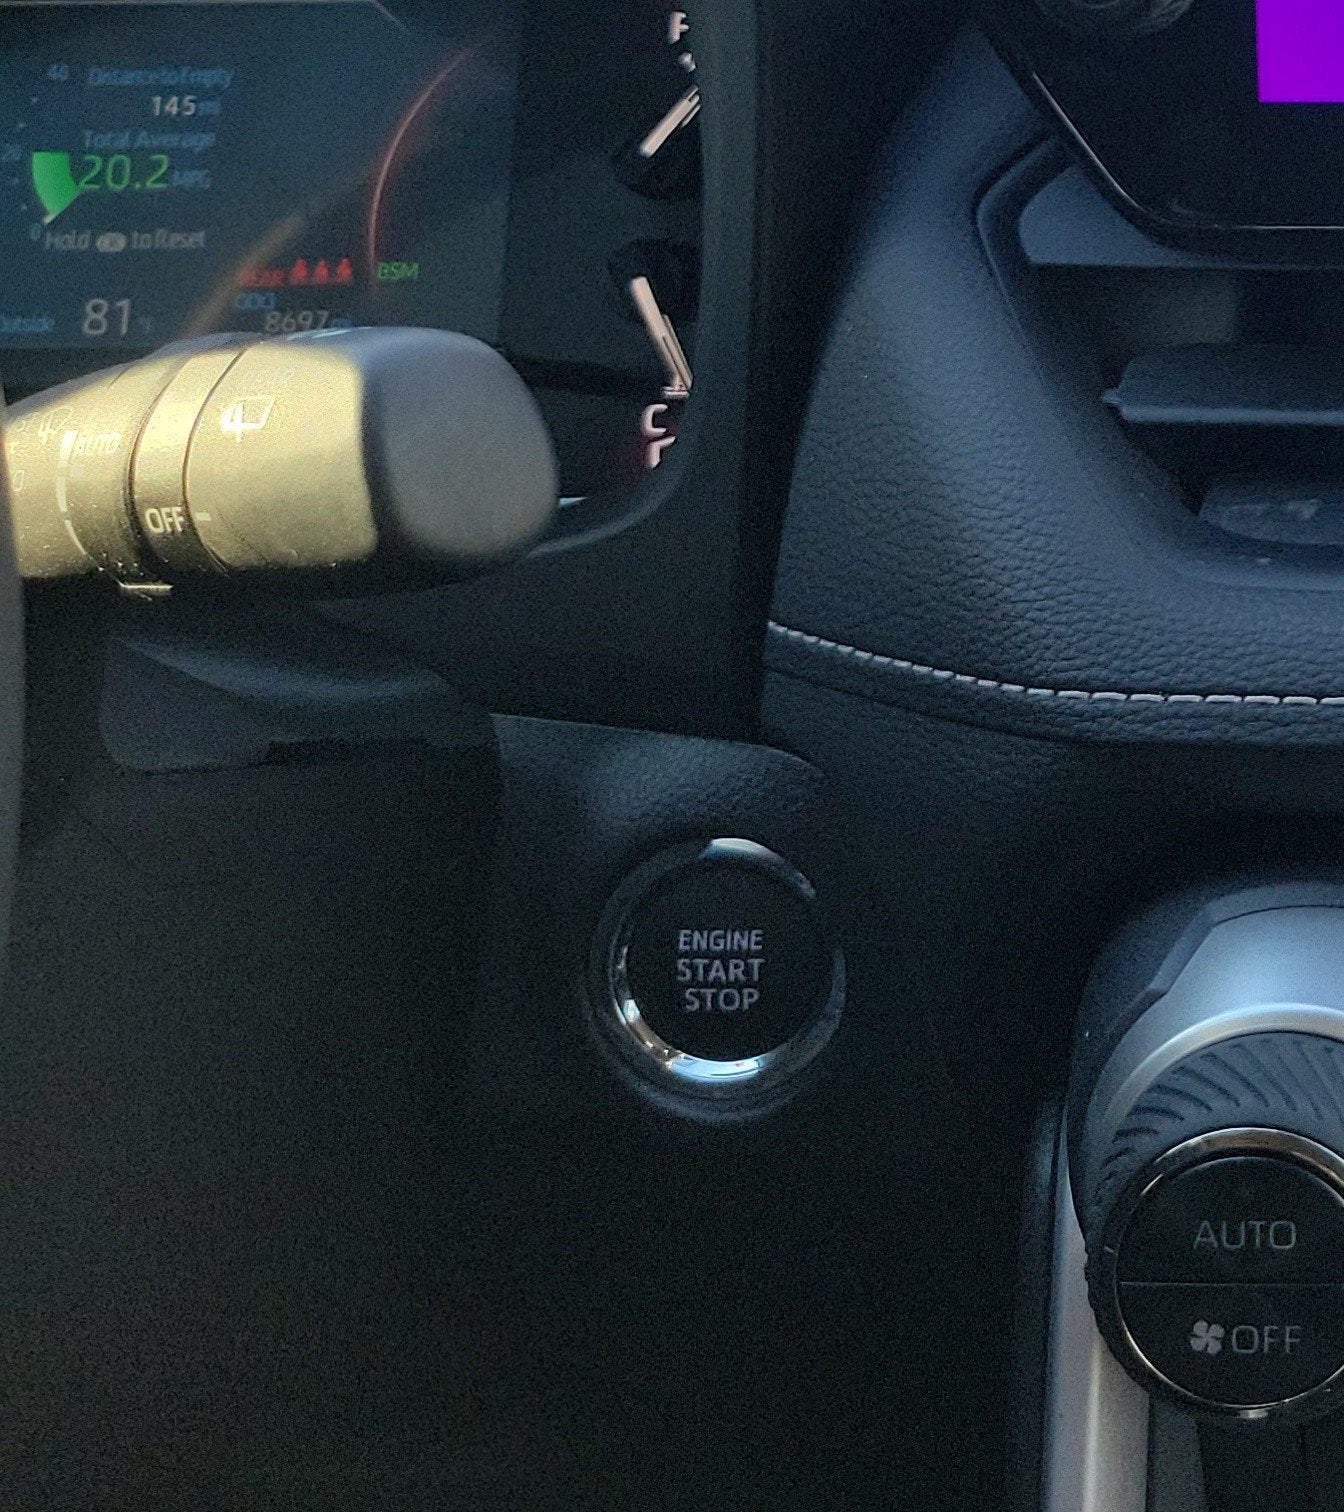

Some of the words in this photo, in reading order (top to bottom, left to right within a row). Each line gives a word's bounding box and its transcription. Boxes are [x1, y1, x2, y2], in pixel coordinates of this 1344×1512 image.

[667, 12, 690, 43] F
[152, 94, 197, 116] 145
[80, 153, 170, 190] 20.2
[82, 298, 131, 336] 81
[145, 506, 184, 534] OFF
[677, 928, 764, 952] ENGINE
[676, 957, 766, 983] START
[684, 987, 760, 1012] STOP
[1192, 1219, 1298, 1251] AUTO
[1230, 1324, 1302, 1355] OFF
